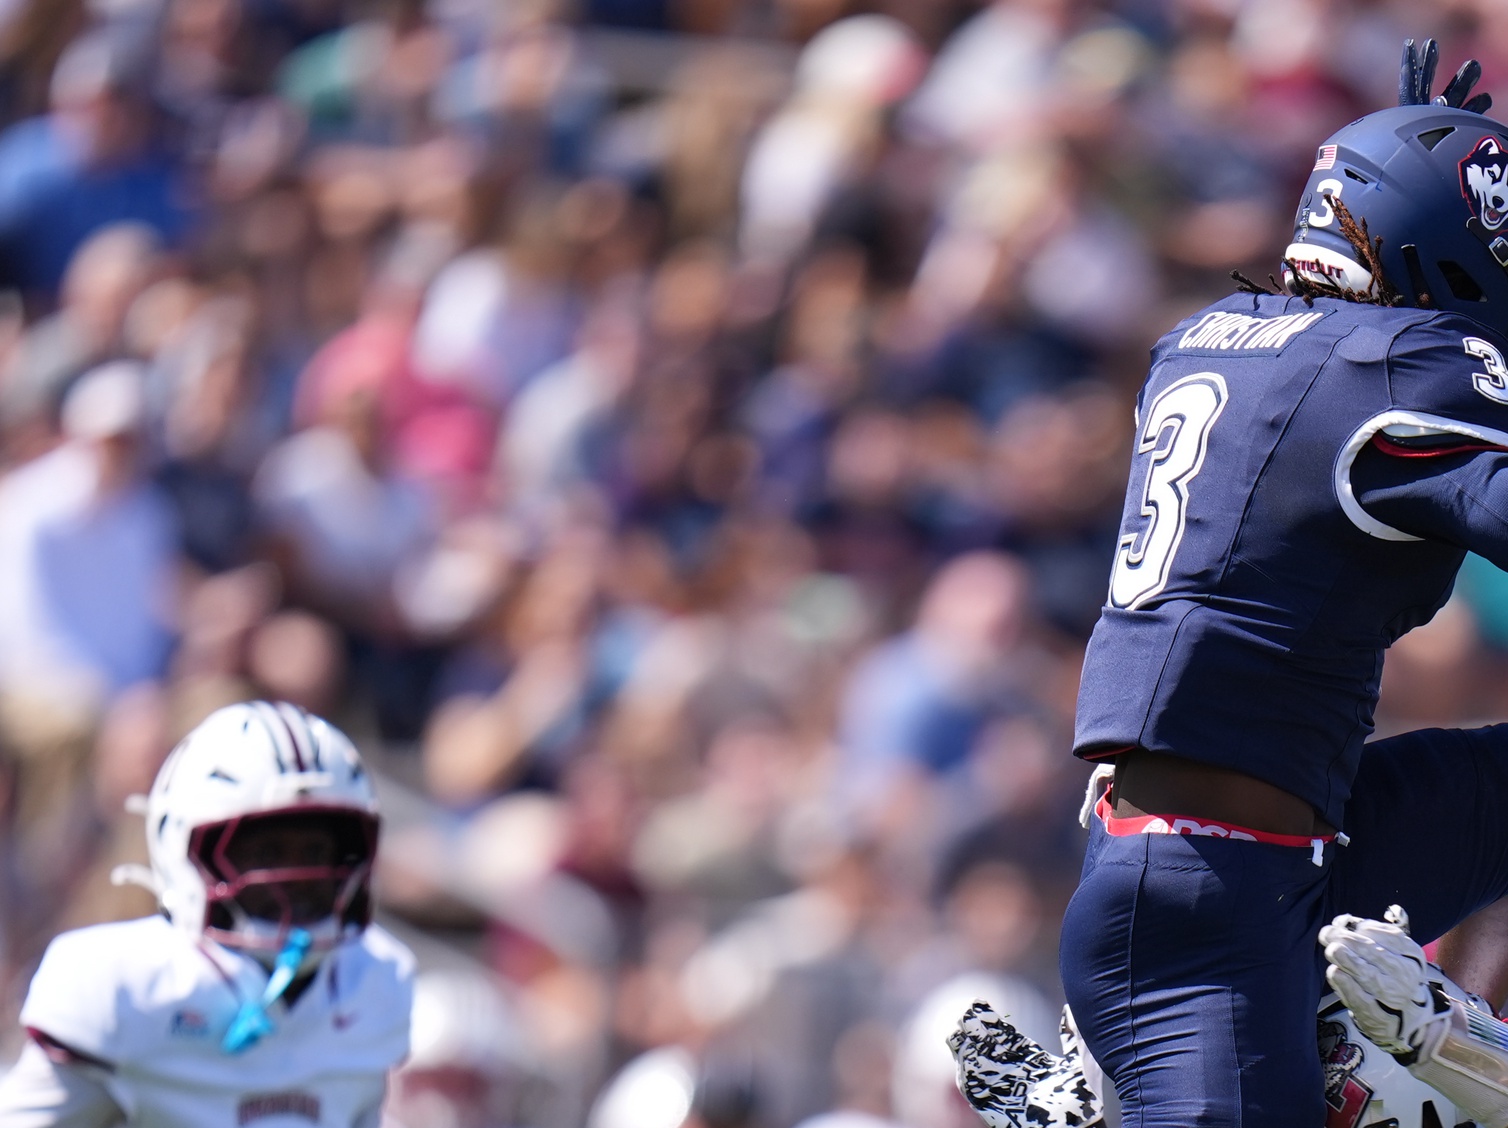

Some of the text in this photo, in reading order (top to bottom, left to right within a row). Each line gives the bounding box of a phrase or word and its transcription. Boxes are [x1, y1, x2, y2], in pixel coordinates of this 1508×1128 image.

[1308, 178, 1343, 228] 3
[1177, 311, 1324, 350] CHRISTIAN
[1107, 371, 1230, 612] 3
